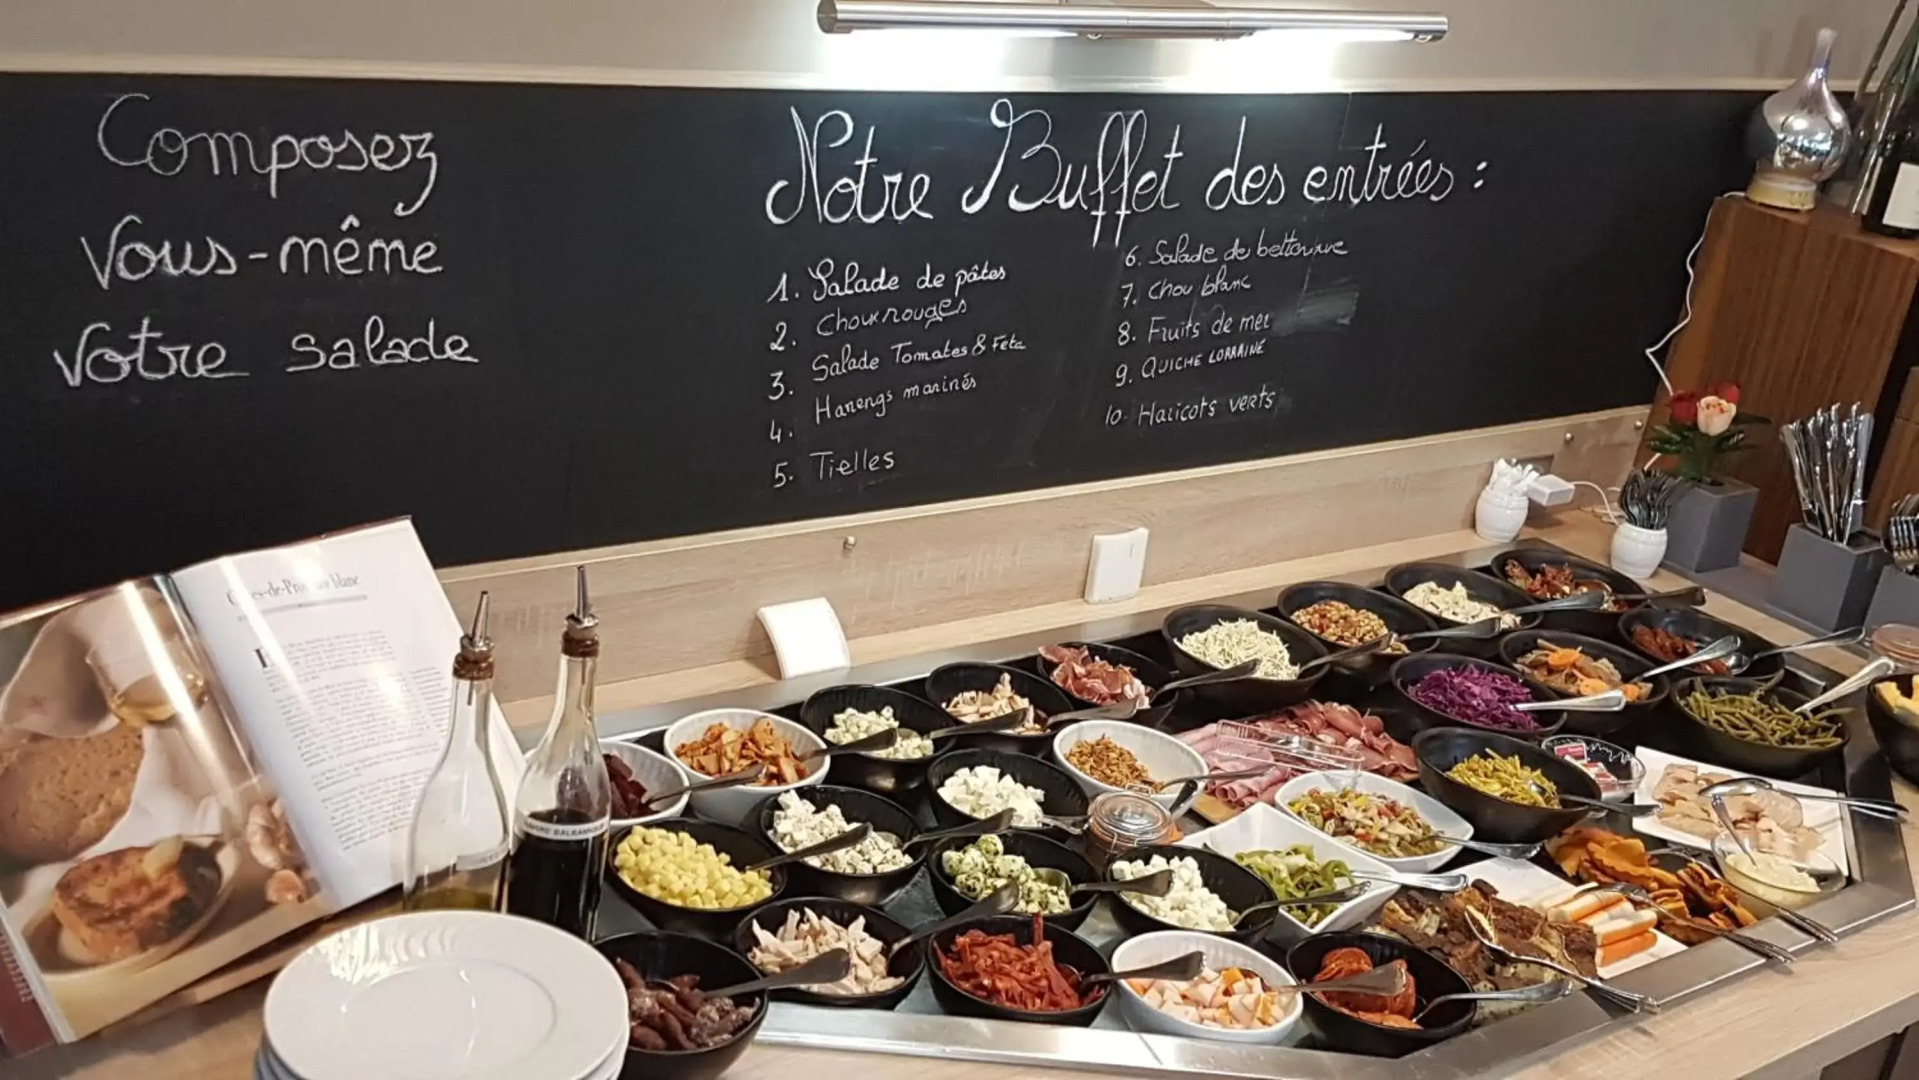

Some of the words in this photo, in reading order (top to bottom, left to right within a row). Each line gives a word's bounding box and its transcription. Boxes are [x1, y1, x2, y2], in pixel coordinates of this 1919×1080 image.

[98, 94, 437, 217] Composez
[766, 105, 934, 224] Notre
[962, 98, 1184, 248] Buffet
[1206, 116, 1285, 210] des
[1303, 122, 1454, 206] entrées
[81, 215, 442, 290] Vous-même
[1149, 234, 1218, 266] Salade
[1224, 238, 1251, 260] de
[767, 272, 800, 303] 1.
[808, 257, 900, 302] Salade
[917, 262, 946, 290] de
[955, 260, 1006, 298] pâtes
[1201, 265, 1252, 298] blanc
[770, 321, 797, 353] 2.
[1148, 315, 1200, 344] Fruits
[1211, 310, 1233, 336] de
[1239, 313, 1270, 332] mer
[769, 370, 795, 401] 3.
[812, 343, 880, 382] Salade
[891, 339, 968, 365] Tomates
[971, 333, 987, 356] &
[992, 332, 1027, 352] Feta
[1141, 355, 1202, 380] QUICHE
[769, 420, 794, 444] 4.
[815, 389, 893, 425] Harengs
[903, 373, 977, 400] marinés
[1138, 396, 1218, 426] Haricots
[773, 461, 795, 488] 5.
[809, 449, 895, 480] Tielles
